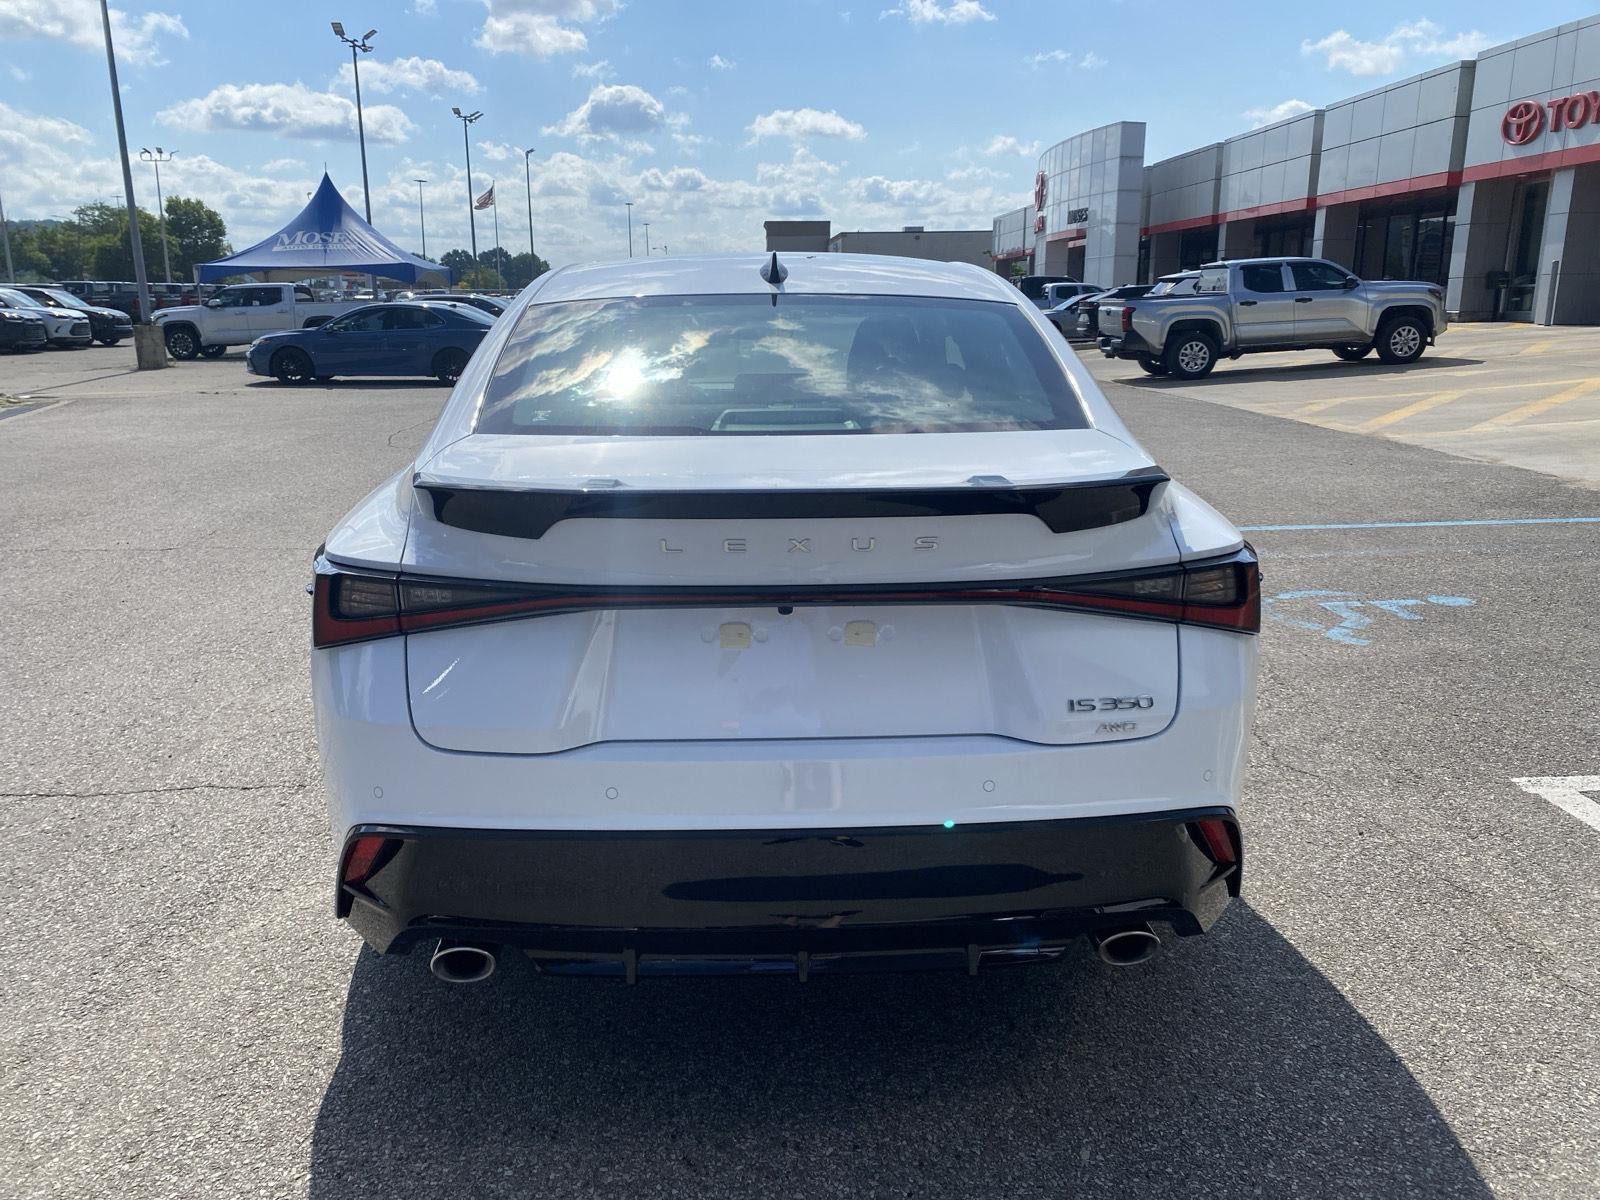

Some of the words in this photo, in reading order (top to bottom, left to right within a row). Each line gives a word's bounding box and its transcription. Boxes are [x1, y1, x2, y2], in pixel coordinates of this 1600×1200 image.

[661, 537, 938, 553] LEXUS
[1068, 699, 1097, 713] IS
[1098, 696, 1154, 711] 350
[1096, 721, 1137, 733] AWD
